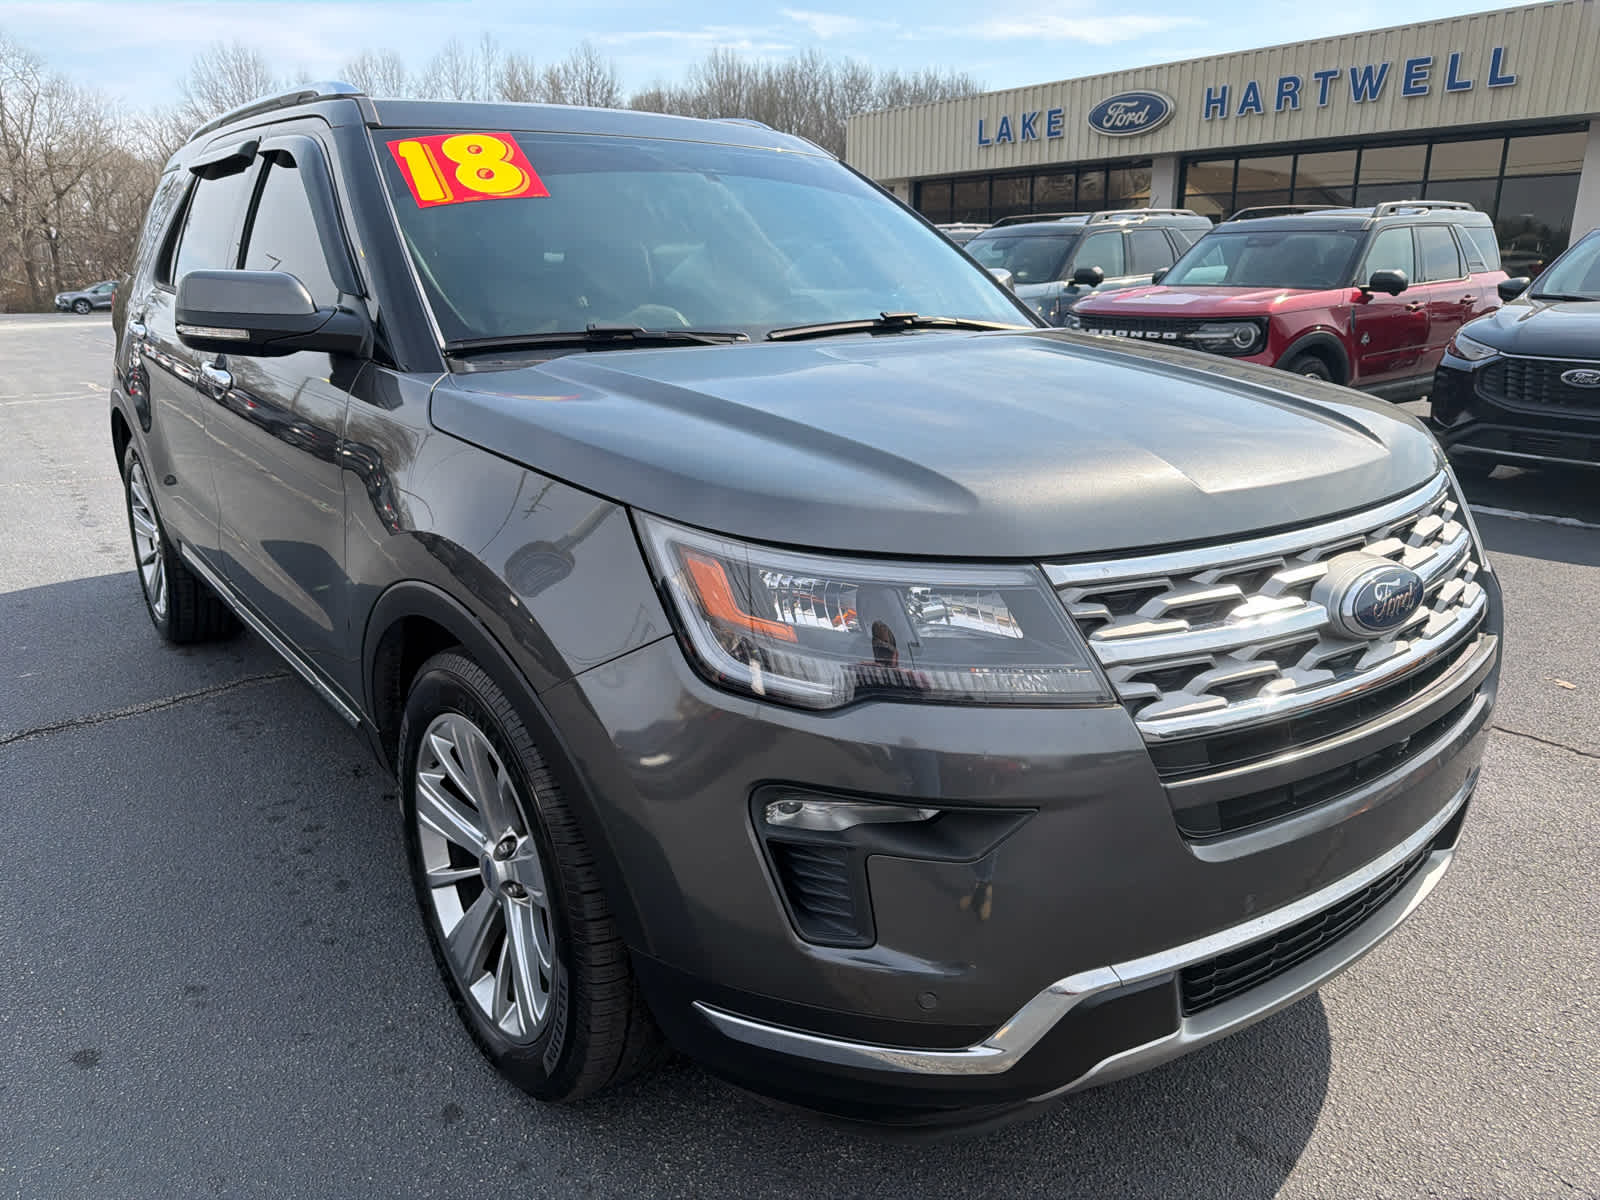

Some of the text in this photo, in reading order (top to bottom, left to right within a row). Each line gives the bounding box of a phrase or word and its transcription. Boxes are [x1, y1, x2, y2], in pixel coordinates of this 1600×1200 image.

[977, 46, 1518, 147] LAKE Ford HARTWELL
[398, 133, 531, 203] 18
[1088, 328, 1177, 340] BRONCO
[1571, 372, 1600, 384] Ford
[1371, 577, 1418, 620] Ford
